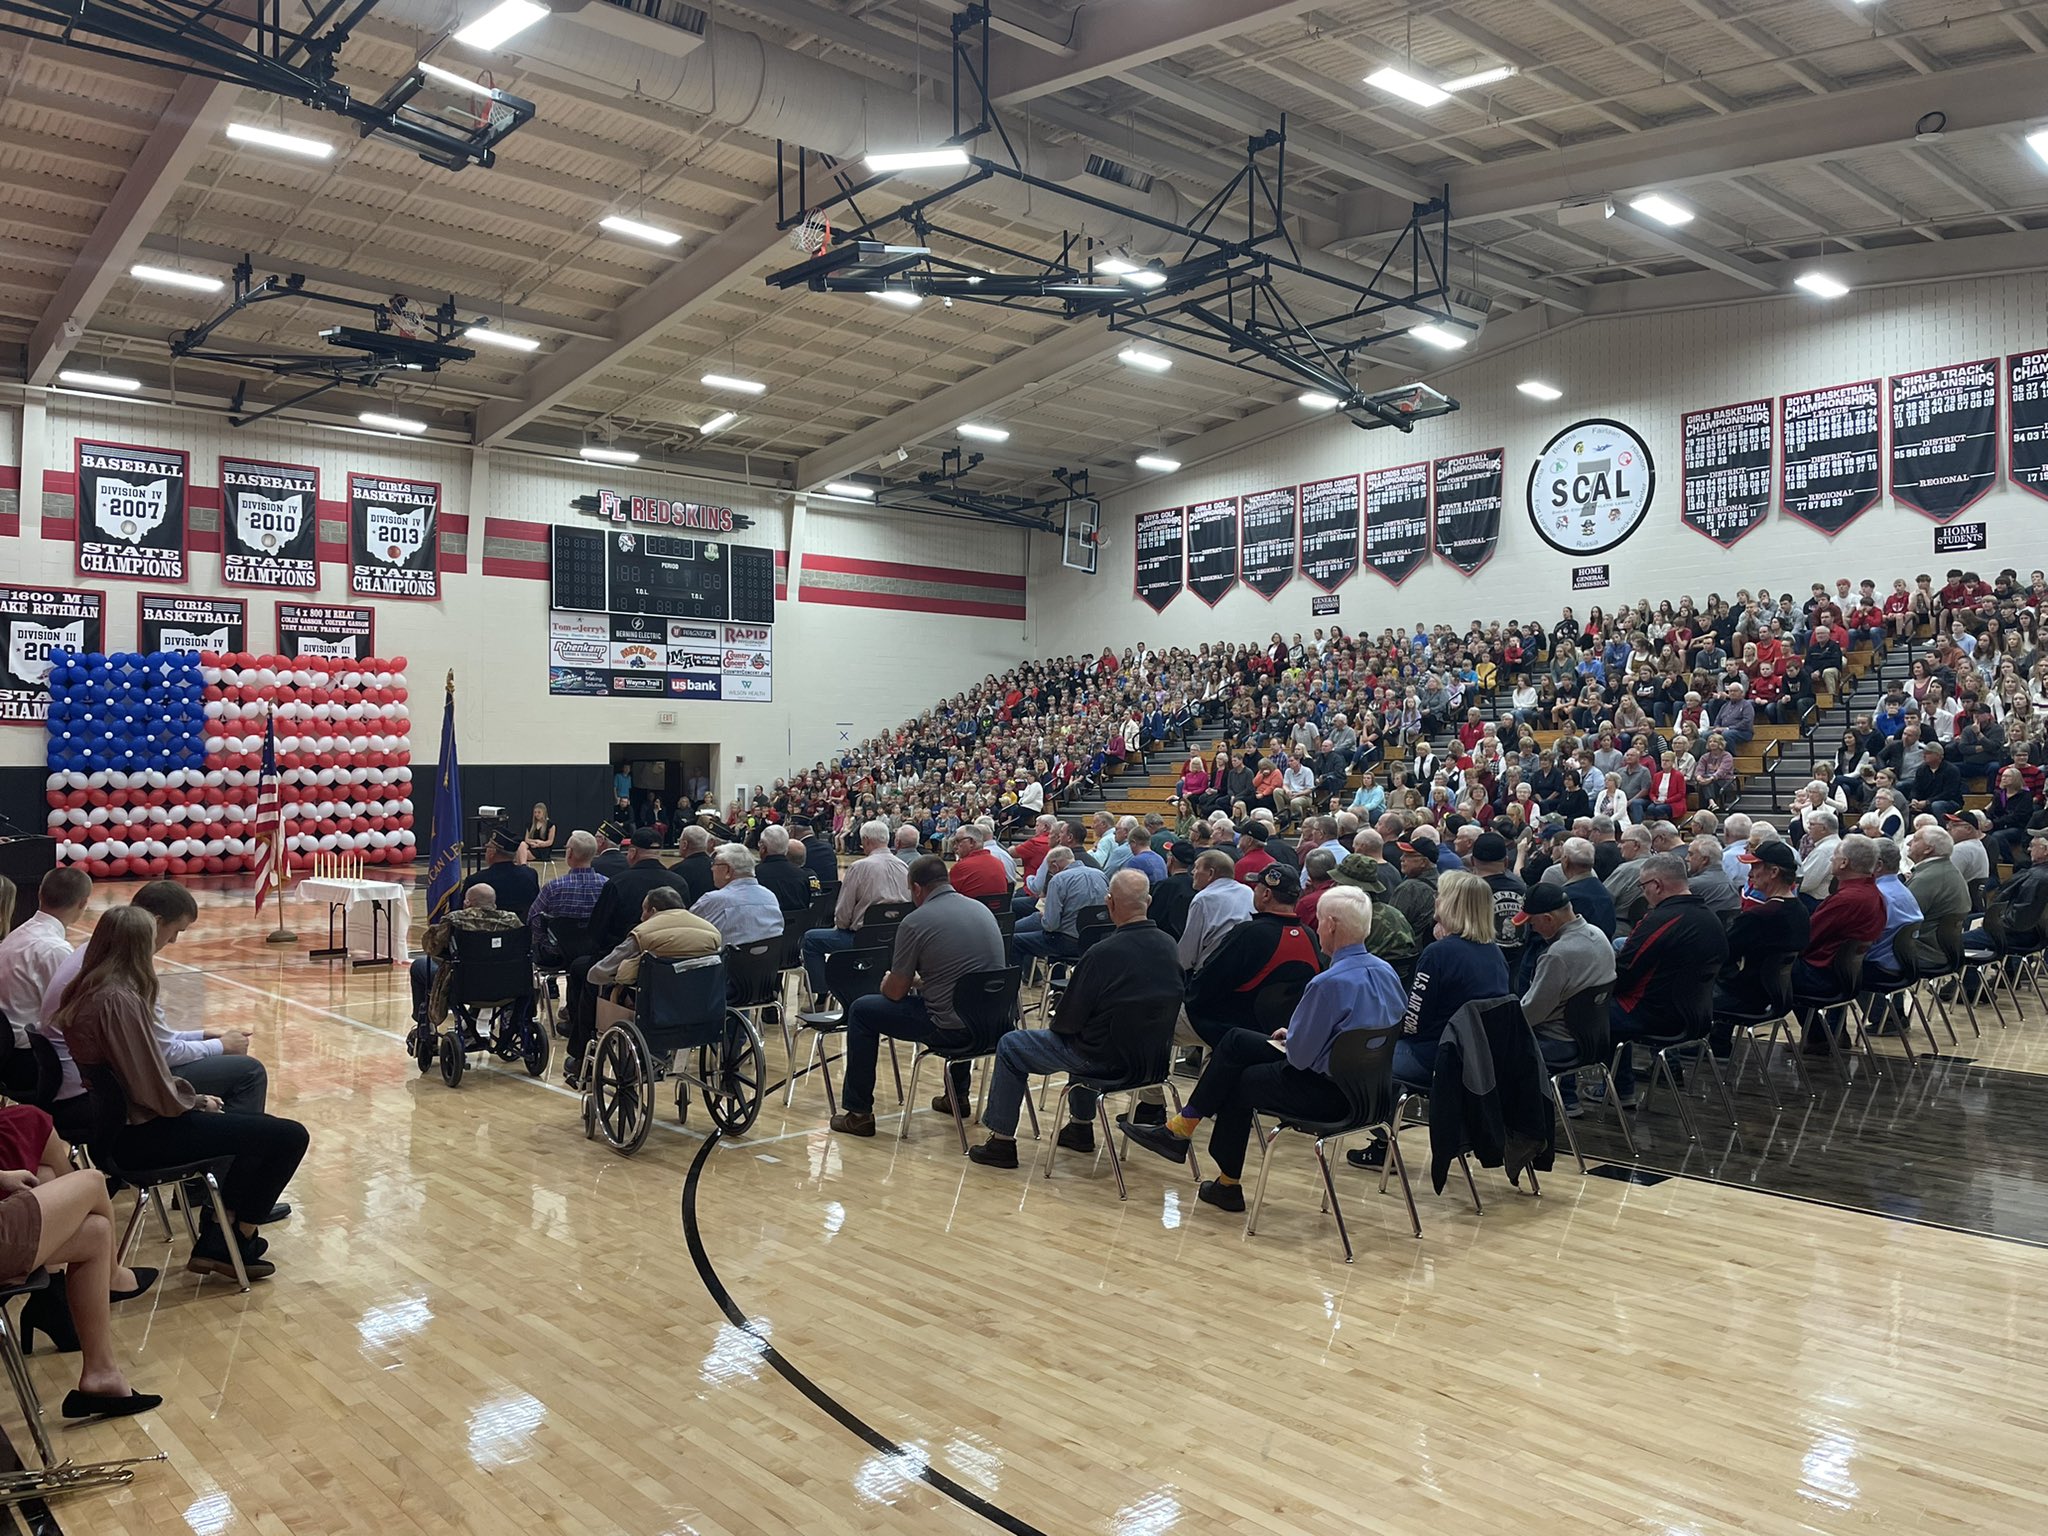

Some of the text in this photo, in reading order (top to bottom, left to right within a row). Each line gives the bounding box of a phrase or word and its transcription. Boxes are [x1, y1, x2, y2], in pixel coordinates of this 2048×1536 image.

[1901, 364, 1985, 387] GIRLS TRACK
[1894, 371, 1994, 402] CHAMPIONSHIPS
[1924, 387, 1963, 399] LEAGUE
[1984, 388, 1995, 398] 00
[1786, 383, 1875, 407] BOYS BASKETBALL
[2026, 391, 2038, 400] 03
[1785, 391, 1878, 420] CHAMPIONSHIPS
[1812, 406, 1849, 418] LEAGUE
[1931, 402, 1969, 415] 04 07
[1687, 403, 1768, 424] GIRLS BASKETBALL
[1686, 411, 1769, 437] CHAMPIONSHIPS
[1711, 424, 1744, 435] LEAGUE
[1922, 434, 1966, 447] DISTRICT
[2027, 432, 2039, 441] 03
[1932, 445, 1943, 454] 03
[1448, 454, 1489, 467] FOOTBALL
[1811, 451, 1852, 464] DISTRICT
[81, 454, 183, 477] BASEBALL
[1402, 465, 1427, 475] COUNTRY
[1437, 459, 1501, 480] CHAMPIONSHIPS
[1447, 472, 1491, 484] CONFERENCE
[1709, 467, 1746, 479] DISTRICT
[224, 472, 316, 492] BASEBALL
[378, 481, 411, 493] GIRLS
[1367, 472, 1427, 493] CHAMPIONSHIPS
[1385, 483, 1408, 491] LEAGUE
[1919, 474, 1969, 487] REGIONAL
[101, 485, 162, 499] DIVISION IV
[1303, 484, 1358, 504] CHAMPIONSHIPS
[1551, 470, 1631, 507] SCAL
[1808, 489, 1854, 501] REGIONAL
[352, 487, 437, 506] BASKETBALL
[1463, 496, 1497, 507] PLAYOFFS
[110, 498, 159, 519] 2007
[242, 500, 298, 514] DIVISION IV
[599, 490, 733, 531] FL REDSKINS
[1214, 501, 1229, 510] GOLF
[1244, 496, 1294, 514] CHAMPIONSHIPS
[1706, 503, 1749, 515] REGIONAL
[371, 514, 421, 526] DIVISION IV
[1144, 511, 1175, 522] BOYS GOLF
[1189, 506, 1235, 524] CHAMPIONSHIPS
[250, 512, 295, 532] 2010
[1137, 516, 1181, 532] CHAMPIONSHIPS
[1617, 509, 1638, 535] Jackson
[379, 526, 418, 544] 2013
[1943, 525, 1978, 536] HOME
[1453, 538, 1486, 547] REGIONAL
[1576, 540, 1599, 548] Russia
[1937, 533, 1983, 544] STUDENTS
[82, 542, 179, 560] STATE
[1382, 549, 1412, 557] REGIONAL
[80, 553, 182, 578] CHAMPIONS
[226, 554, 313, 570] STATE
[661, 562, 679, 570] PERIOD
[225, 565, 316, 586] CHAMPIONS
[354, 565, 433, 580] STATE
[1576, 574, 1605, 582] GENERAL
[1578, 567, 1603, 576] HOME
[353, 576, 436, 596] CHAMPIONS
[1573, 580, 1608, 589] ADMISSION
[10, 591, 82, 604] 1600 M
[1313, 596, 1339, 604] GENERAL
[32, 603, 99, 618] RETHMAN
[175, 600, 212, 611] GIRLS
[143, 608, 242, 625] BASKETBALL
[310, 609, 323, 617] 800
[325, 610, 331, 618] M
[333, 610, 355, 619] RELAY
[552, 622, 571, 631] Tom
[18, 630, 76, 642] DIVISION III
[638, 632, 661, 640] ELECTRIC
[725, 627, 768, 644] RAPID
[165, 637, 224, 648] DIVISION IV
[304, 644, 350, 654] DIVISION III
[726, 650, 751, 660] Country
[723, 657, 747, 668] Concert
[1413, 972, 1430, 991] U.S.
[1408, 991, 1423, 1012] AIR
